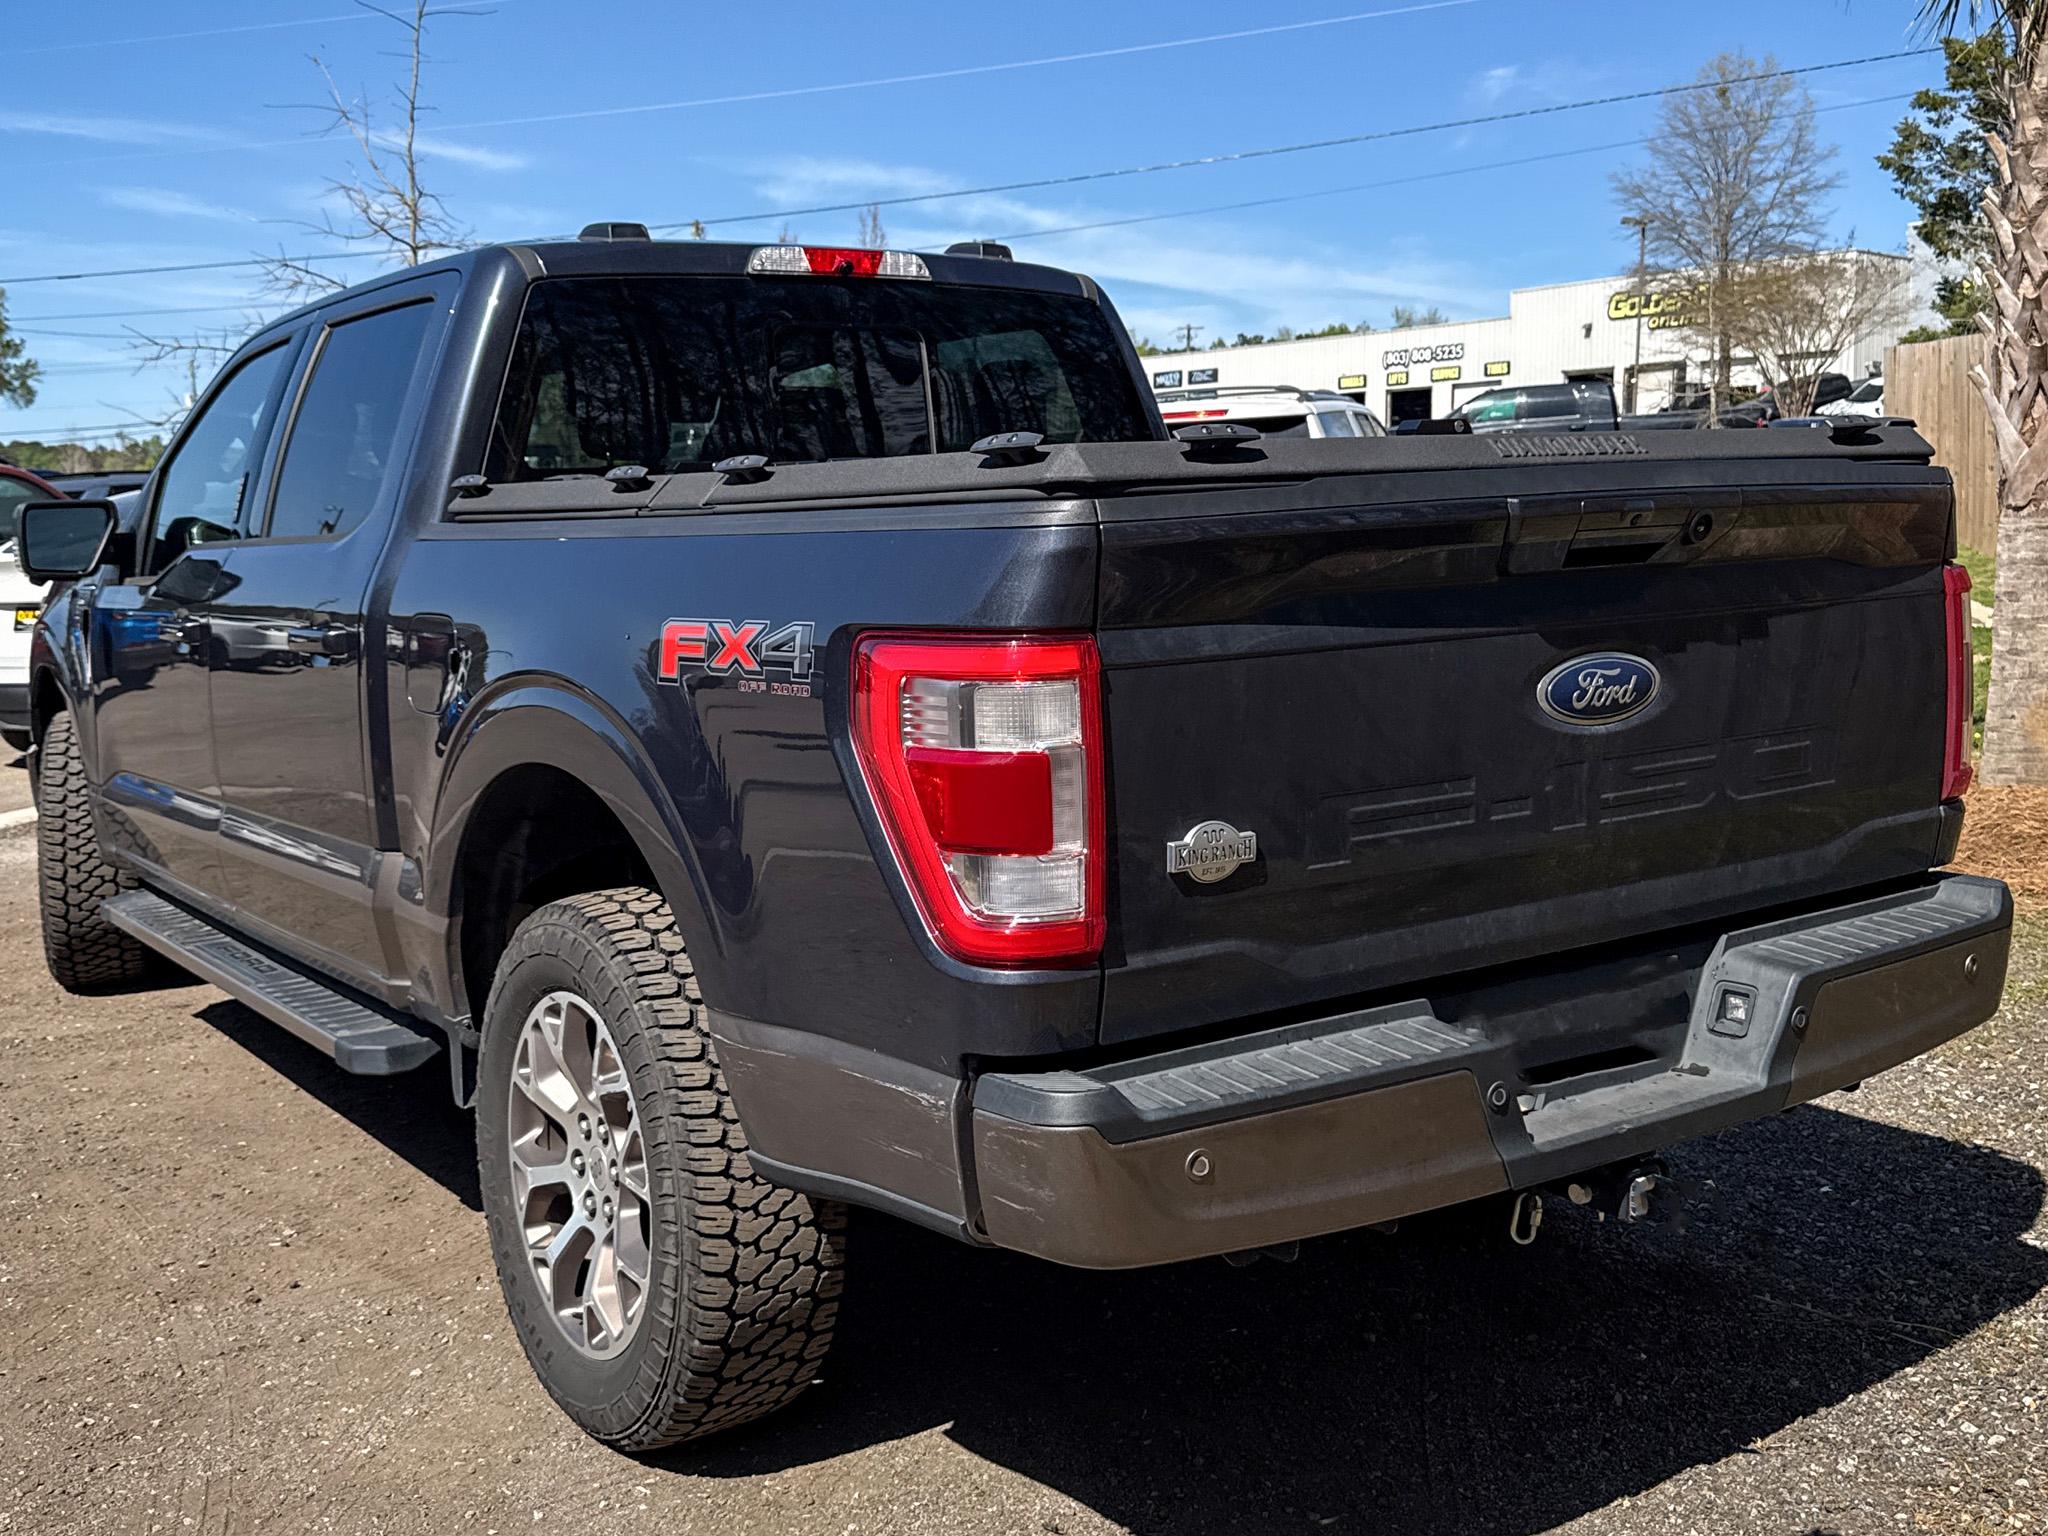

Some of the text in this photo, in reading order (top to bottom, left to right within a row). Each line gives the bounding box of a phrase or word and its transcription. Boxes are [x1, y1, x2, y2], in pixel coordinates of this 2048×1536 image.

[1382, 343, 1464, 370] (803) 808-5235
[657, 617, 815, 686] FX4
[738, 680, 811, 697] OFF ROAD
[1572, 667, 1638, 710] Ford
[1304, 727, 1837, 870] F-150
[1178, 839, 1253, 868] KING RANCH
